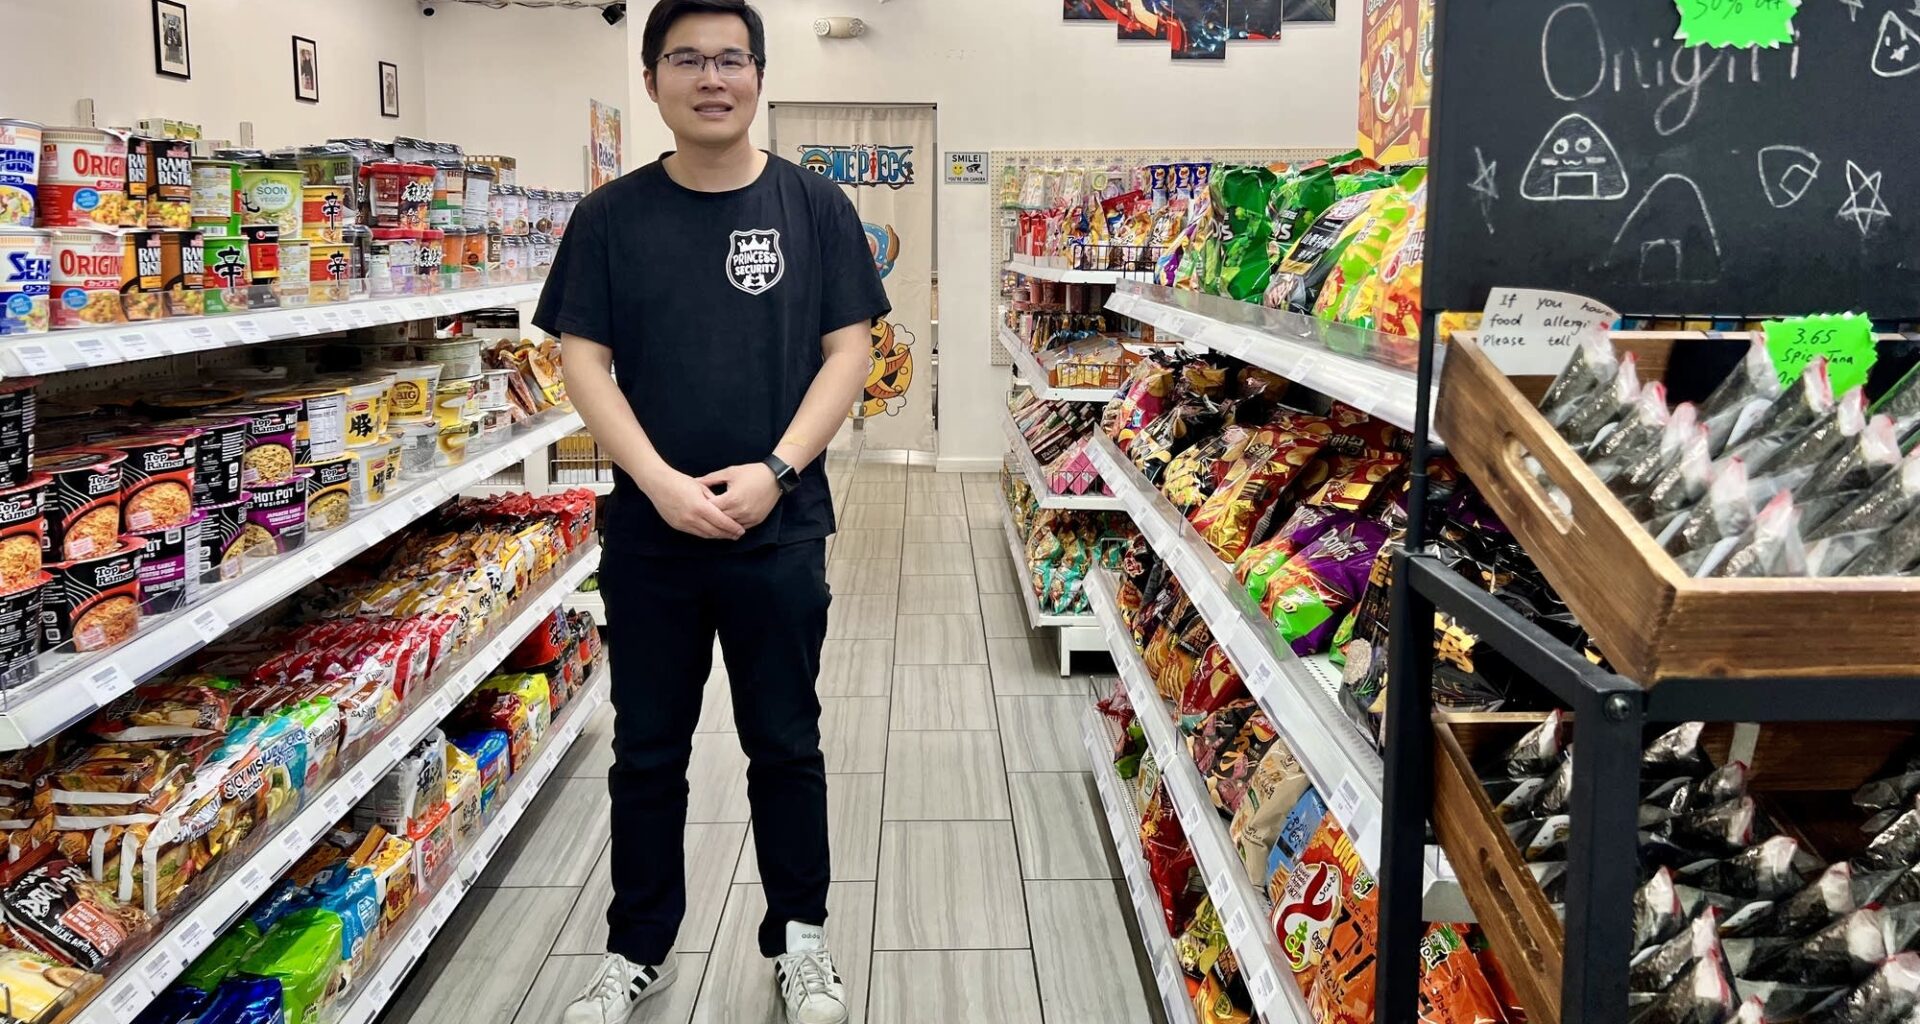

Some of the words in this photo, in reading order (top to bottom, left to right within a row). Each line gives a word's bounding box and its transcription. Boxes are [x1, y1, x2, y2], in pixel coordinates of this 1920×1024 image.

[858, 149, 914, 183] PIECE
[952, 154, 982, 166] SMILE!
[256, 187, 288, 195] SOON
[321, 191, 342, 231] 辛
[733, 250, 777, 266] PRINCESS
[214, 245, 246, 294] 辛
[734, 264, 776, 276] SECURITY
[1499, 293, 1517, 308] If
[1537, 297, 1562, 310] you
[1490, 313, 1523, 327] food
[1483, 336, 1527, 347] Please
[1548, 336, 1571, 347] tell
[1792, 328, 1837, 345] 3.65
[396, 391, 416, 400] BIG
[252, 417, 273, 429] Top
[252, 423, 285, 435] Ramen
[348, 413, 374, 437] 豚
[144, 451, 169, 465] Top
[146, 458, 184, 473] Ramen
[89, 472, 110, 487] Top
[322, 467, 338, 478] Top
[253, 491, 274, 505] HOT
[275, 485, 294, 502] POT
[258, 499, 290, 509] FUSIONS
[1318, 527, 1355, 562] Doritos
[95, 566, 120, 582] Top
[96, 570, 136, 588] Ramen
